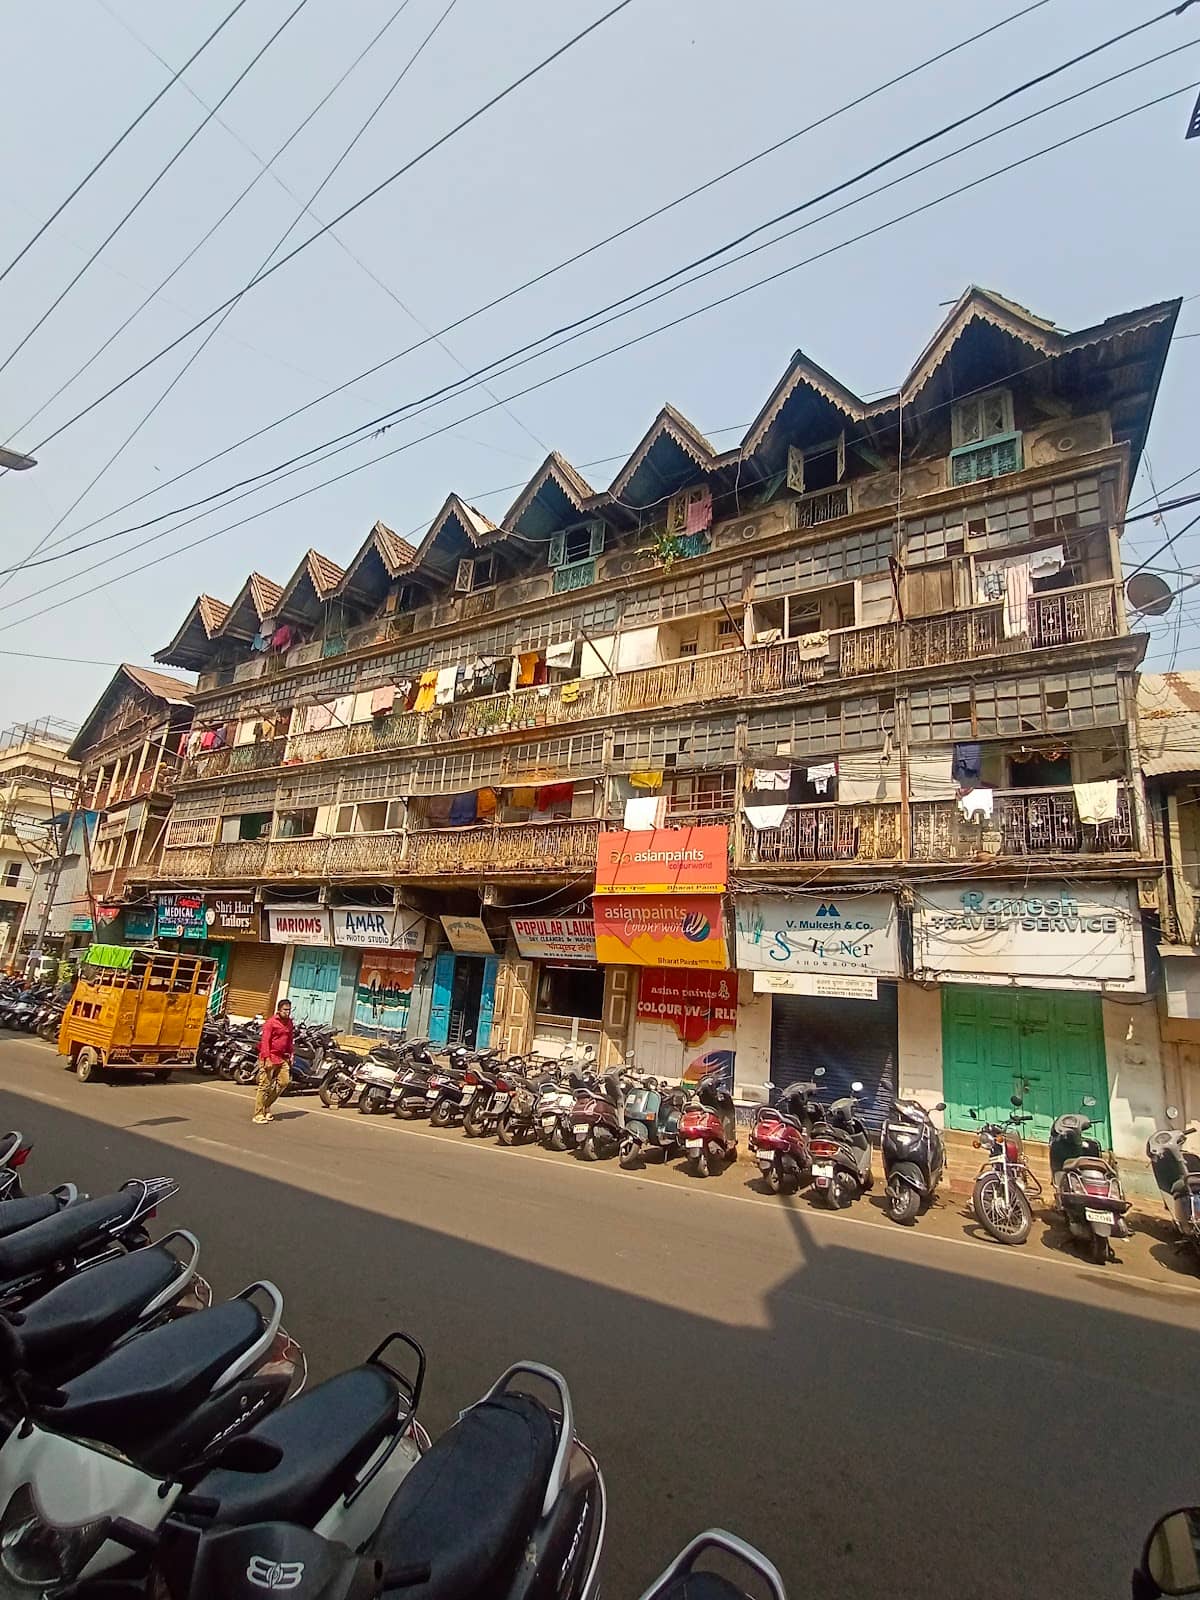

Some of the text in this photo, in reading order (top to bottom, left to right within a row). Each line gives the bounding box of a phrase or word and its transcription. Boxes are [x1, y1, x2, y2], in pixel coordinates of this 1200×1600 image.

[634, 848, 704, 867] asianpaints
[215, 900, 232, 913] Shri
[233, 901, 254, 914] Hari
[960, 890, 1079, 916] Ramesh
[164, 907, 194, 918] MEDICAL
[604, 903, 687, 922] asianpaints
[220, 914, 250, 928] Tailors
[276, 916, 322, 933] HARIOM'S
[515, 920, 563, 936] POPULAR
[624, 919, 658, 936] Colour
[786, 920, 874, 930] V. Mukesh & Co.
[931, 916, 1117, 933] TRAVEL SERVICE
[346, 934, 389, 944] PHOTO STUDIO
[651, 985, 718, 999] asian paints
[637, 1001, 682, 1015] COLOUR
